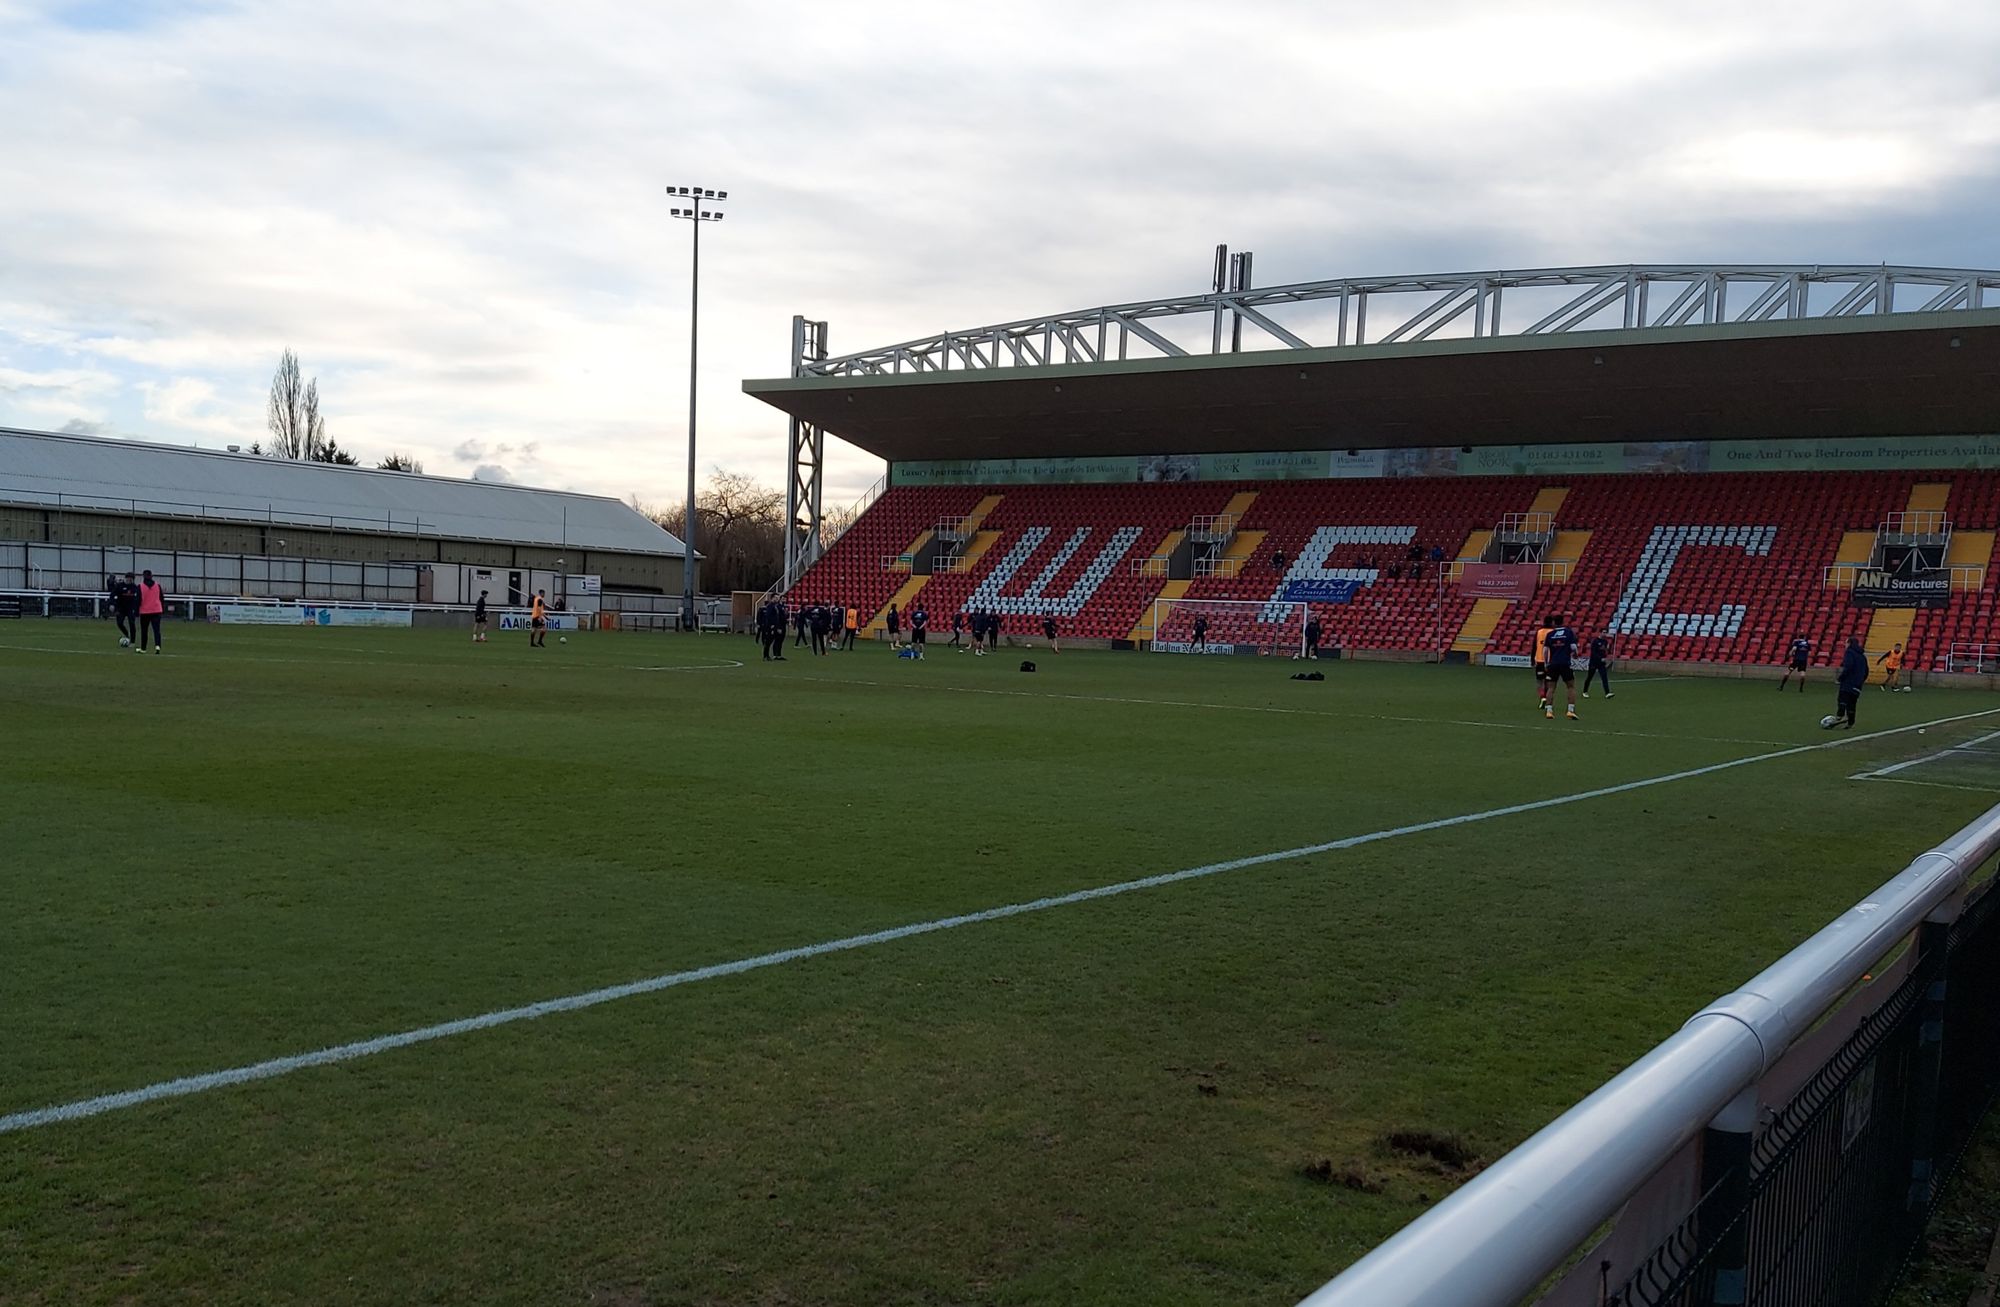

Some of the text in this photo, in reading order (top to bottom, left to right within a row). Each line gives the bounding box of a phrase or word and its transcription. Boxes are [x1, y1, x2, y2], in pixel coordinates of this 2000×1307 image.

[1727, 449, 1753, 460] One
[1757, 449, 1782, 459] And
[1785, 448, 1812, 459] Two
[1815, 447, 1873, 458] Bedroom
[1877, 446, 1947, 459] Properties
[1097, 462, 1130, 474] Woking
[1296, 581, 1354, 590] MKJ
[1608, 525, 1778, 638] C
[1857, 571, 1948, 589] ANT Structures
